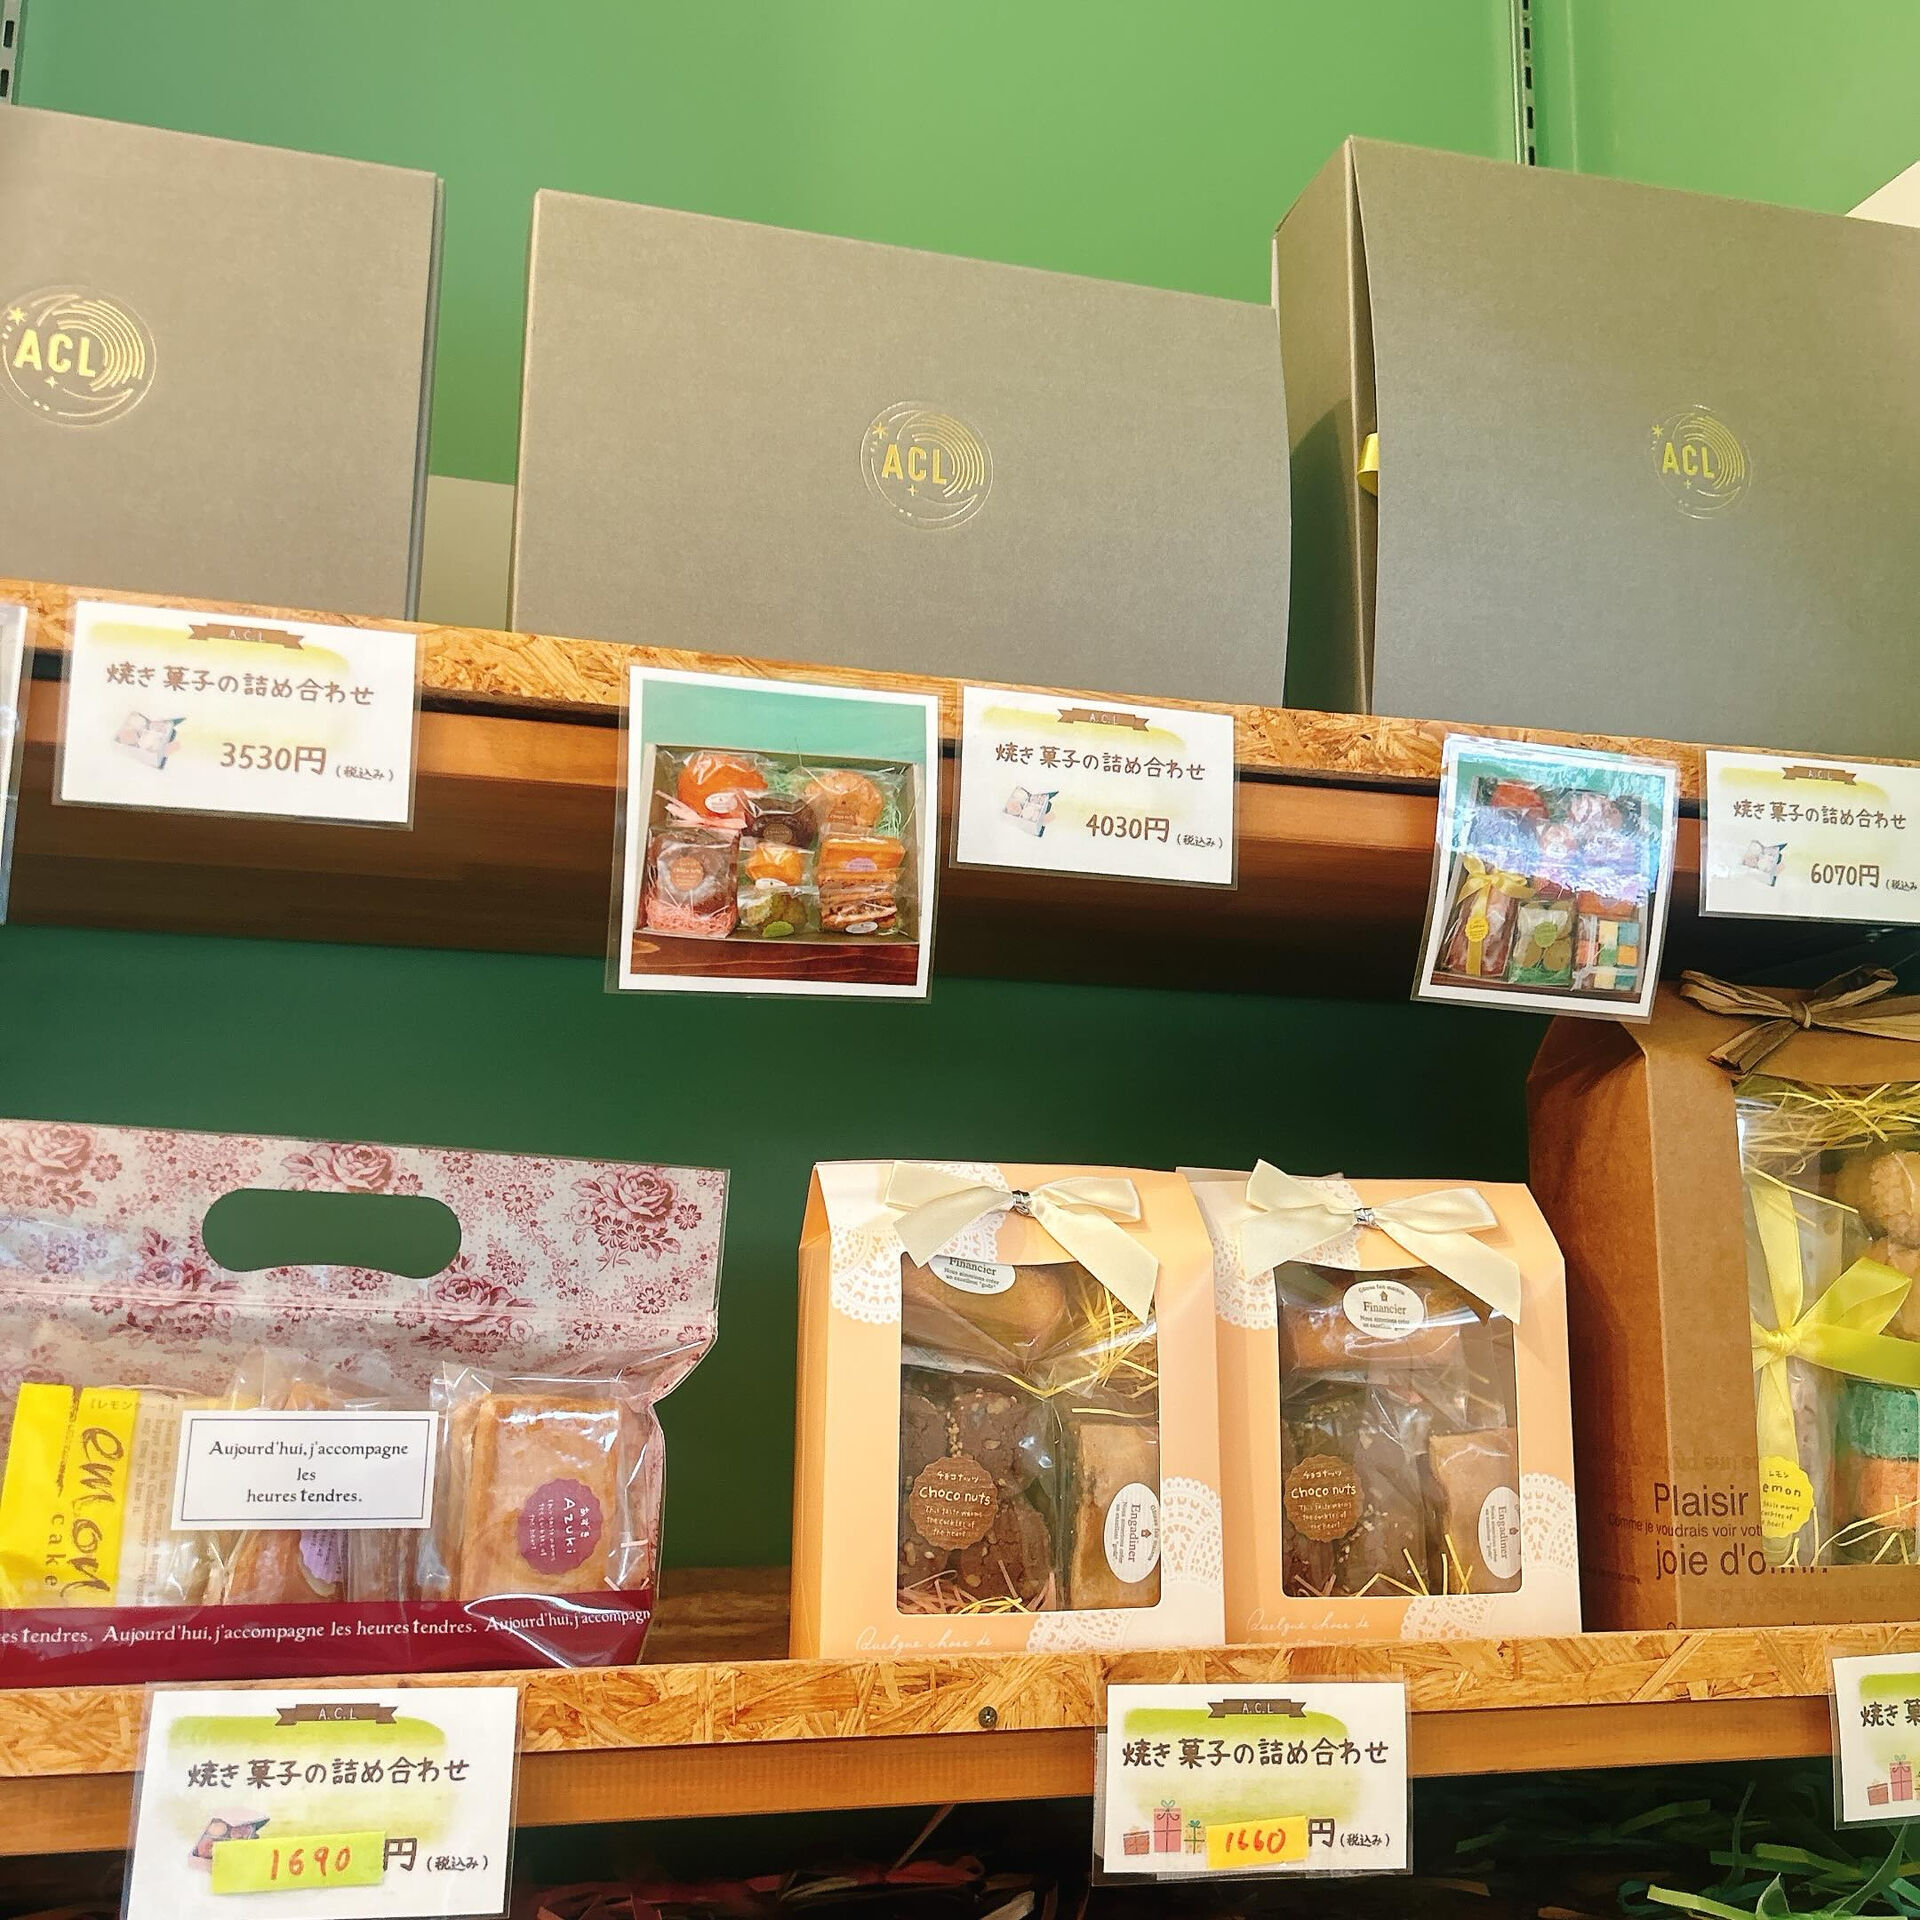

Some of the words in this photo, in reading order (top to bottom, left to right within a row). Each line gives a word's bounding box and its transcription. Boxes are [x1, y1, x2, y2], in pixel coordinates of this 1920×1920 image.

[13, 329, 96, 377] ACL
[881, 444, 947, 485] ACL
[1663, 442, 1716, 478] ACL
[106, 661, 374, 705] 焼き菓子の詰め合わせ
[220, 742, 327, 776] 3530円
[996, 741, 1205, 781] 焼き菓子の詰め合わせ
[1086, 814, 1170, 842] 4030円
[1734, 799, 1906, 830] 焼き菓子の詰め合わせ
[1811, 863, 1880, 888] 6070円
[949, 1257, 996, 1276] Financier
[1364, 1301, 1406, 1314] Financier
[297, 1468, 316, 1482] les
[1332, 1483, 1356, 1495] nuts
[1762, 1484, 1801, 1497] emon
[247, 1489, 296, 1502] heures
[300, 1489, 362, 1502] tendres.
[919, 1486, 960, 1501] Choco
[964, 1492, 991, 1506] nuts
[1654, 1482, 1748, 1517] Plaisir
[564, 1498, 576, 1555] Azuki
[1128, 1504, 1141, 1562] Engadiner
[1497, 1506, 1508, 1559] Engadiner
[1645, 1522, 1654, 1535] je
[1656, 1524, 1708, 1538] voudrais
[1712, 1524, 1737, 1537] voir
[45, 1513, 66, 1587] cake
[1656, 1540, 1708, 1580] joie
[22, 1626, 93, 1644] tendres.
[330, 1621, 352, 1636] les
[356, 1620, 409, 1635] heures
[413, 1618, 477, 1634] tendres.
[1122, 1736, 1389, 1769] 焼き菓子の詰め合わせ
[187, 1756, 470, 1790] 焼き菓子の詰め合わせ
